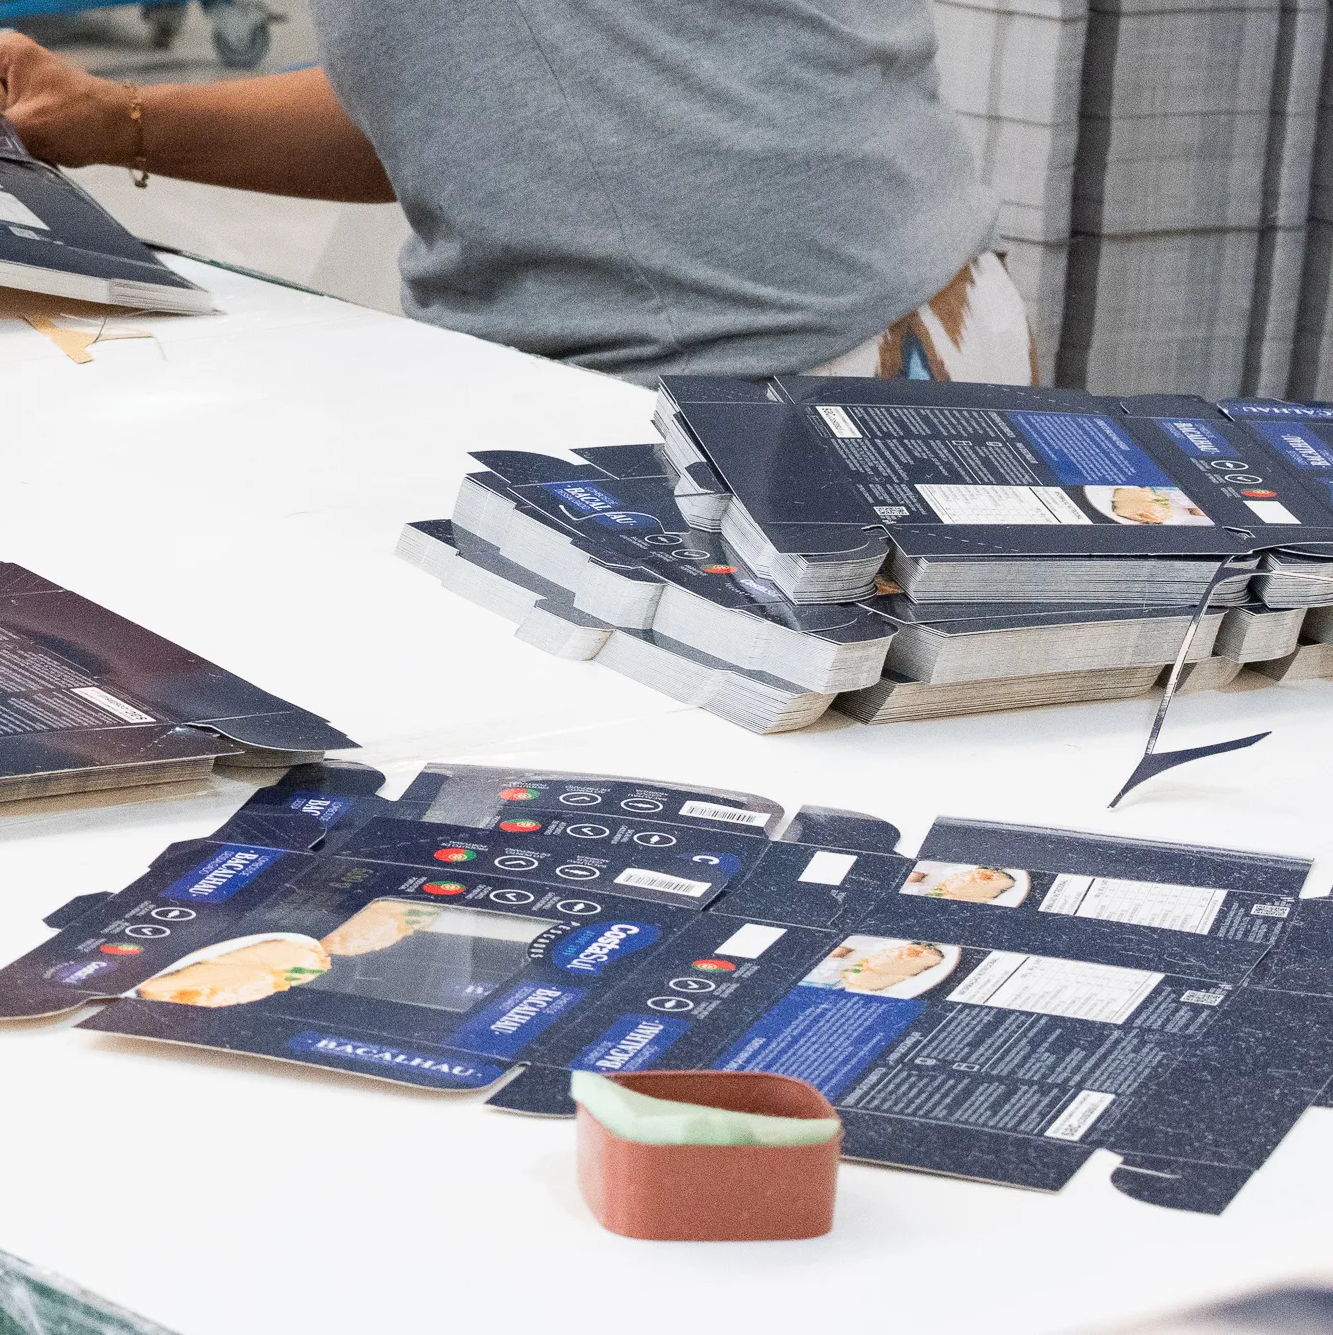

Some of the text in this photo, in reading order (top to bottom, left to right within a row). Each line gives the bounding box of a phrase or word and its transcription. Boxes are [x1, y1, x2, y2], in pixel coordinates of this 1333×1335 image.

[564, 487, 637, 525] BACALAU
[189, 852, 259, 895] BACALHAU
[566, 924, 640, 971] CostaSul
[491, 988, 562, 1034] BACALHAU
[316, 1039, 475, 1077] BACALHAU
[595, 1021, 664, 1069] BACALHAU
